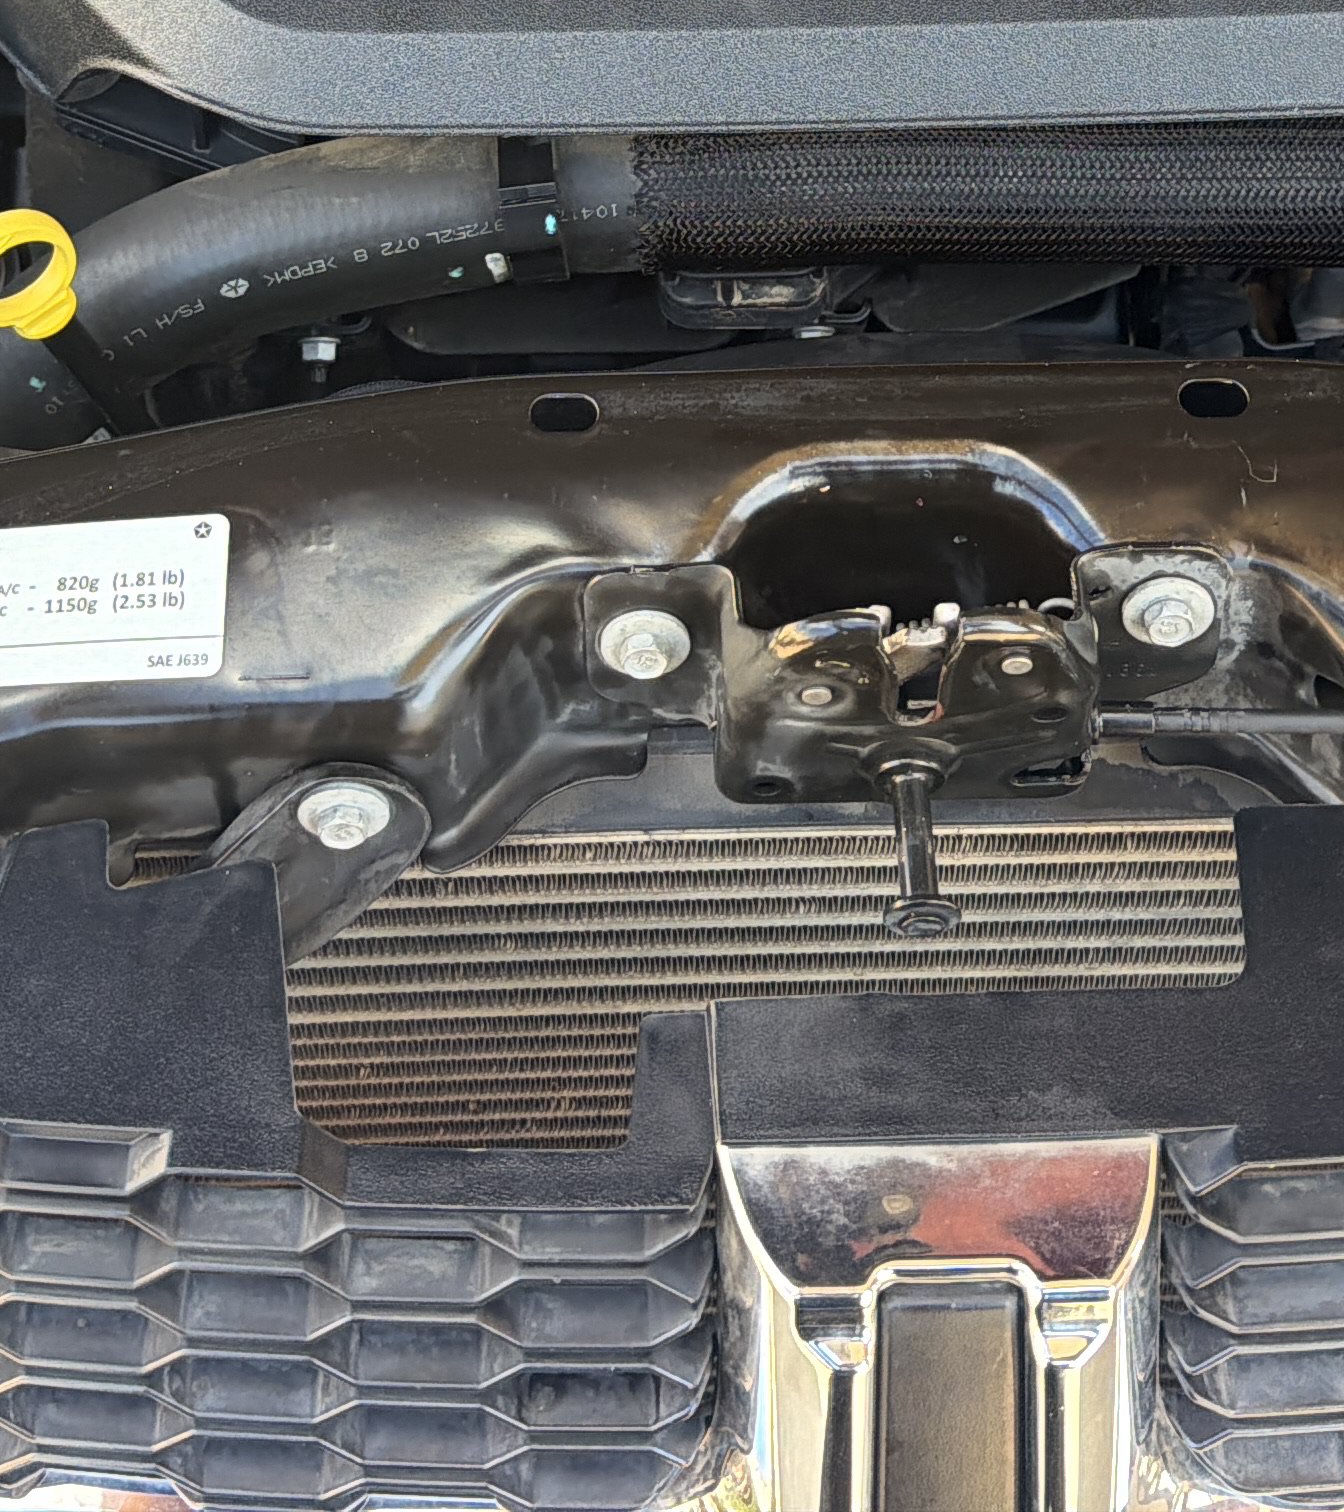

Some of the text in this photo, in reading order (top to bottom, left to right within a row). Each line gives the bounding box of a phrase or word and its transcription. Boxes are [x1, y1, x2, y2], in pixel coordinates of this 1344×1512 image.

[380, 235, 420, 256] 072
[156, 298, 205, 329] FS/H
[57, 575, 99, 593] 820g
[112, 572, 156, 590] (1.81
[162, 569, 185, 587] lb)
[44, 597, 97, 615] 1150g
[112, 594, 157, 612] (2.53
[162, 591, 185, 610] lb)
[147, 653, 208, 669] SAE J639
